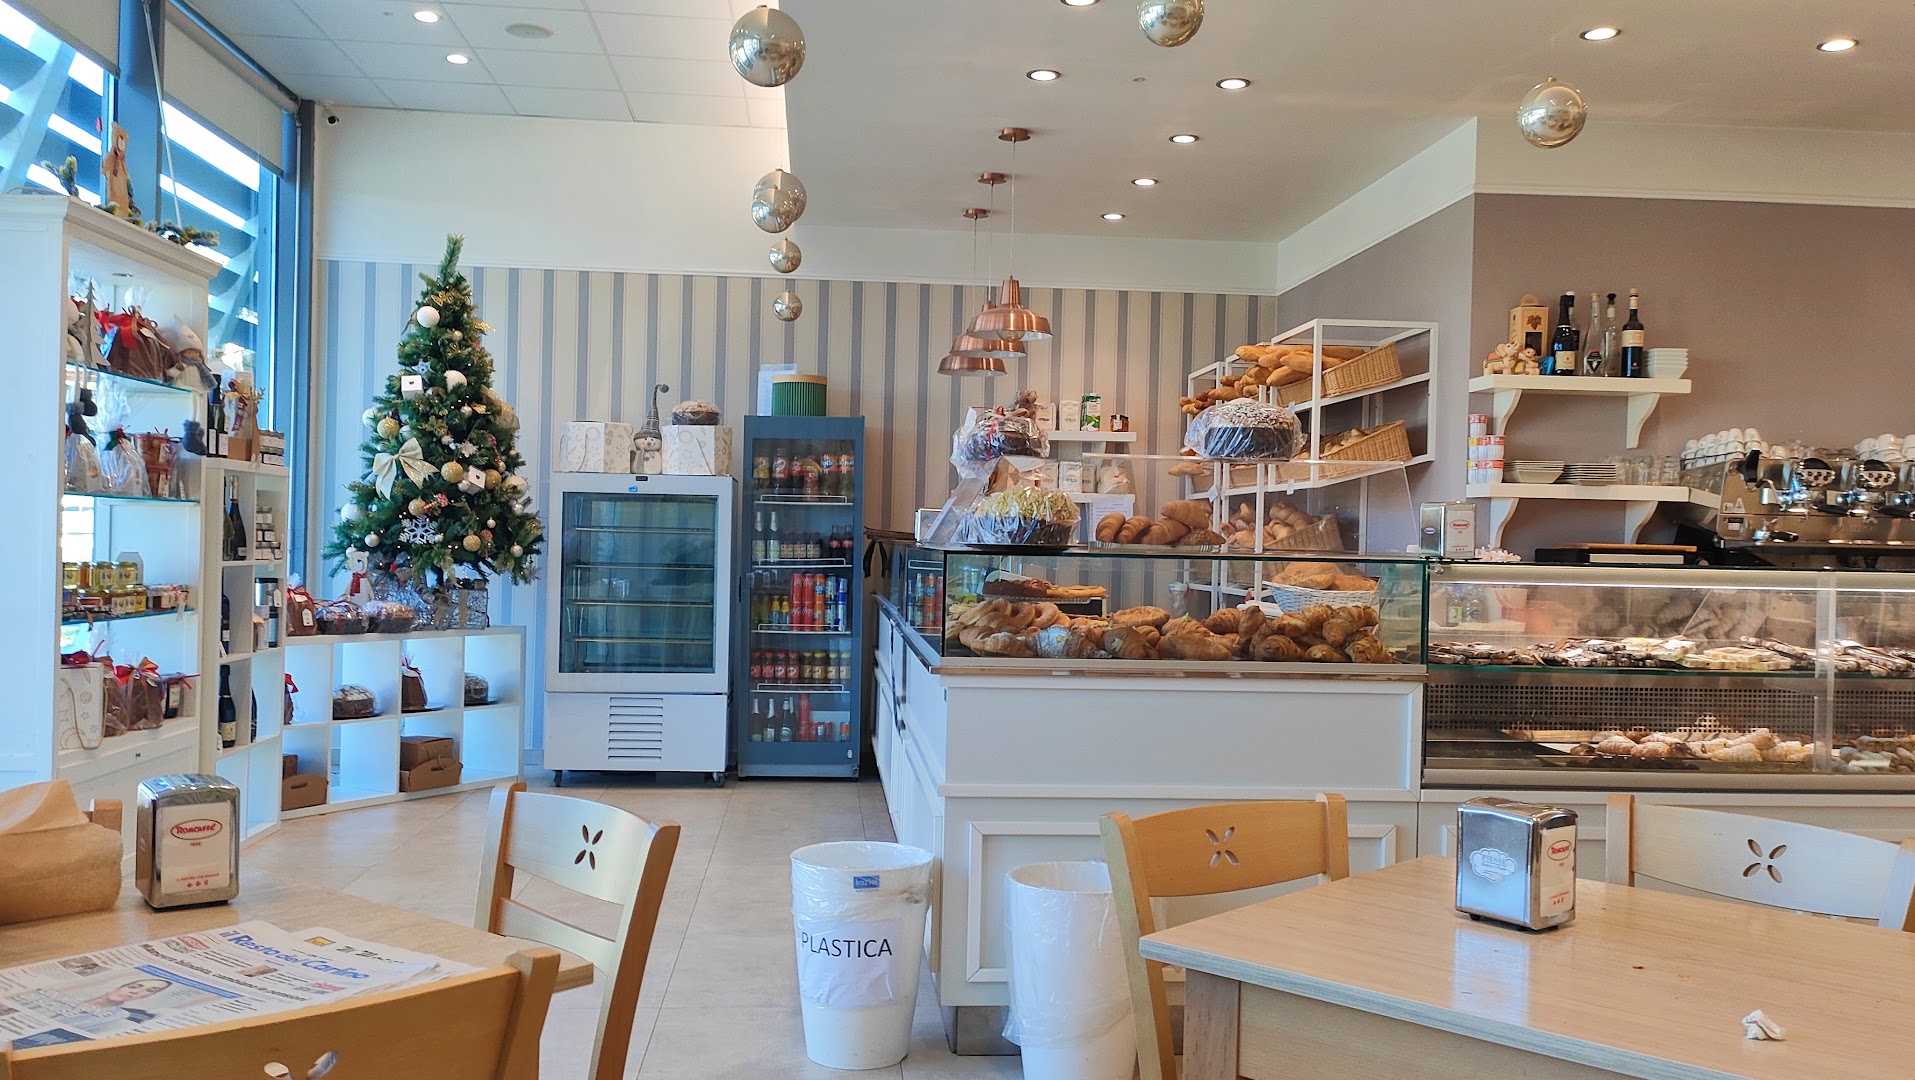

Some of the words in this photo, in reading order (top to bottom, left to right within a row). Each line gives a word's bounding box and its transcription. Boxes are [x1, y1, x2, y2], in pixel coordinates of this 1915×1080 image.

[228, 935, 280, 956] Resto
[301, 959, 370, 979] Carlino
[801, 932, 892, 958] PLASTICA
